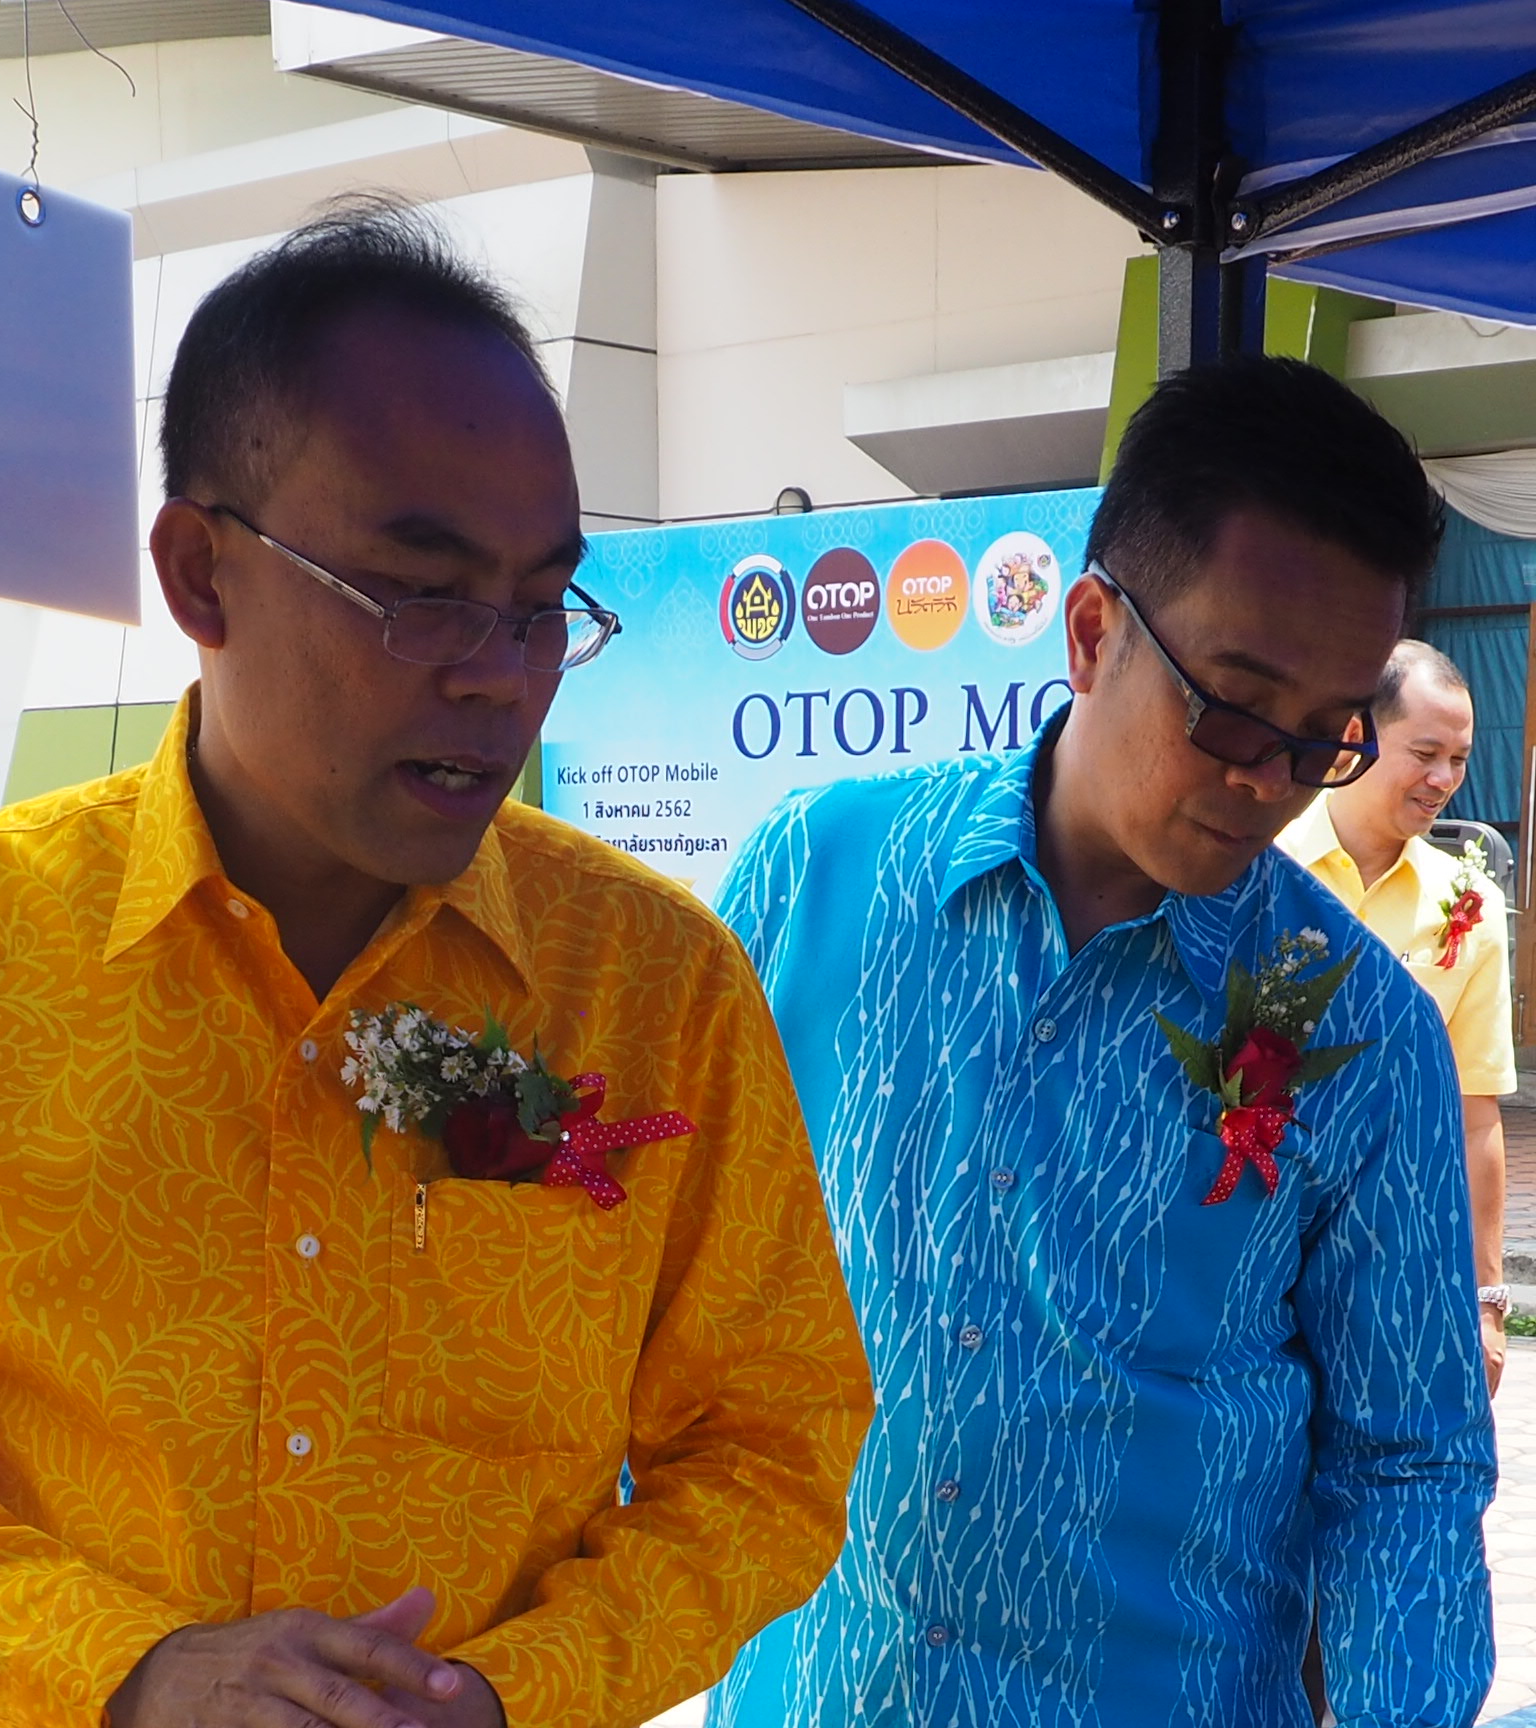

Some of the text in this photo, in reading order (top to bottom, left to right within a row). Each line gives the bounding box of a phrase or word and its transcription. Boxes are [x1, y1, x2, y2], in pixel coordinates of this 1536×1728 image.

[807, 582, 875, 610] OTOP
[902, 576, 952, 595] OTOP
[731, 686, 928, 759] OTOP
[557, 762, 718, 784] Kick off OTOP Mobile
[583, 800, 691, 819] 1 สิงหาคม 2562
